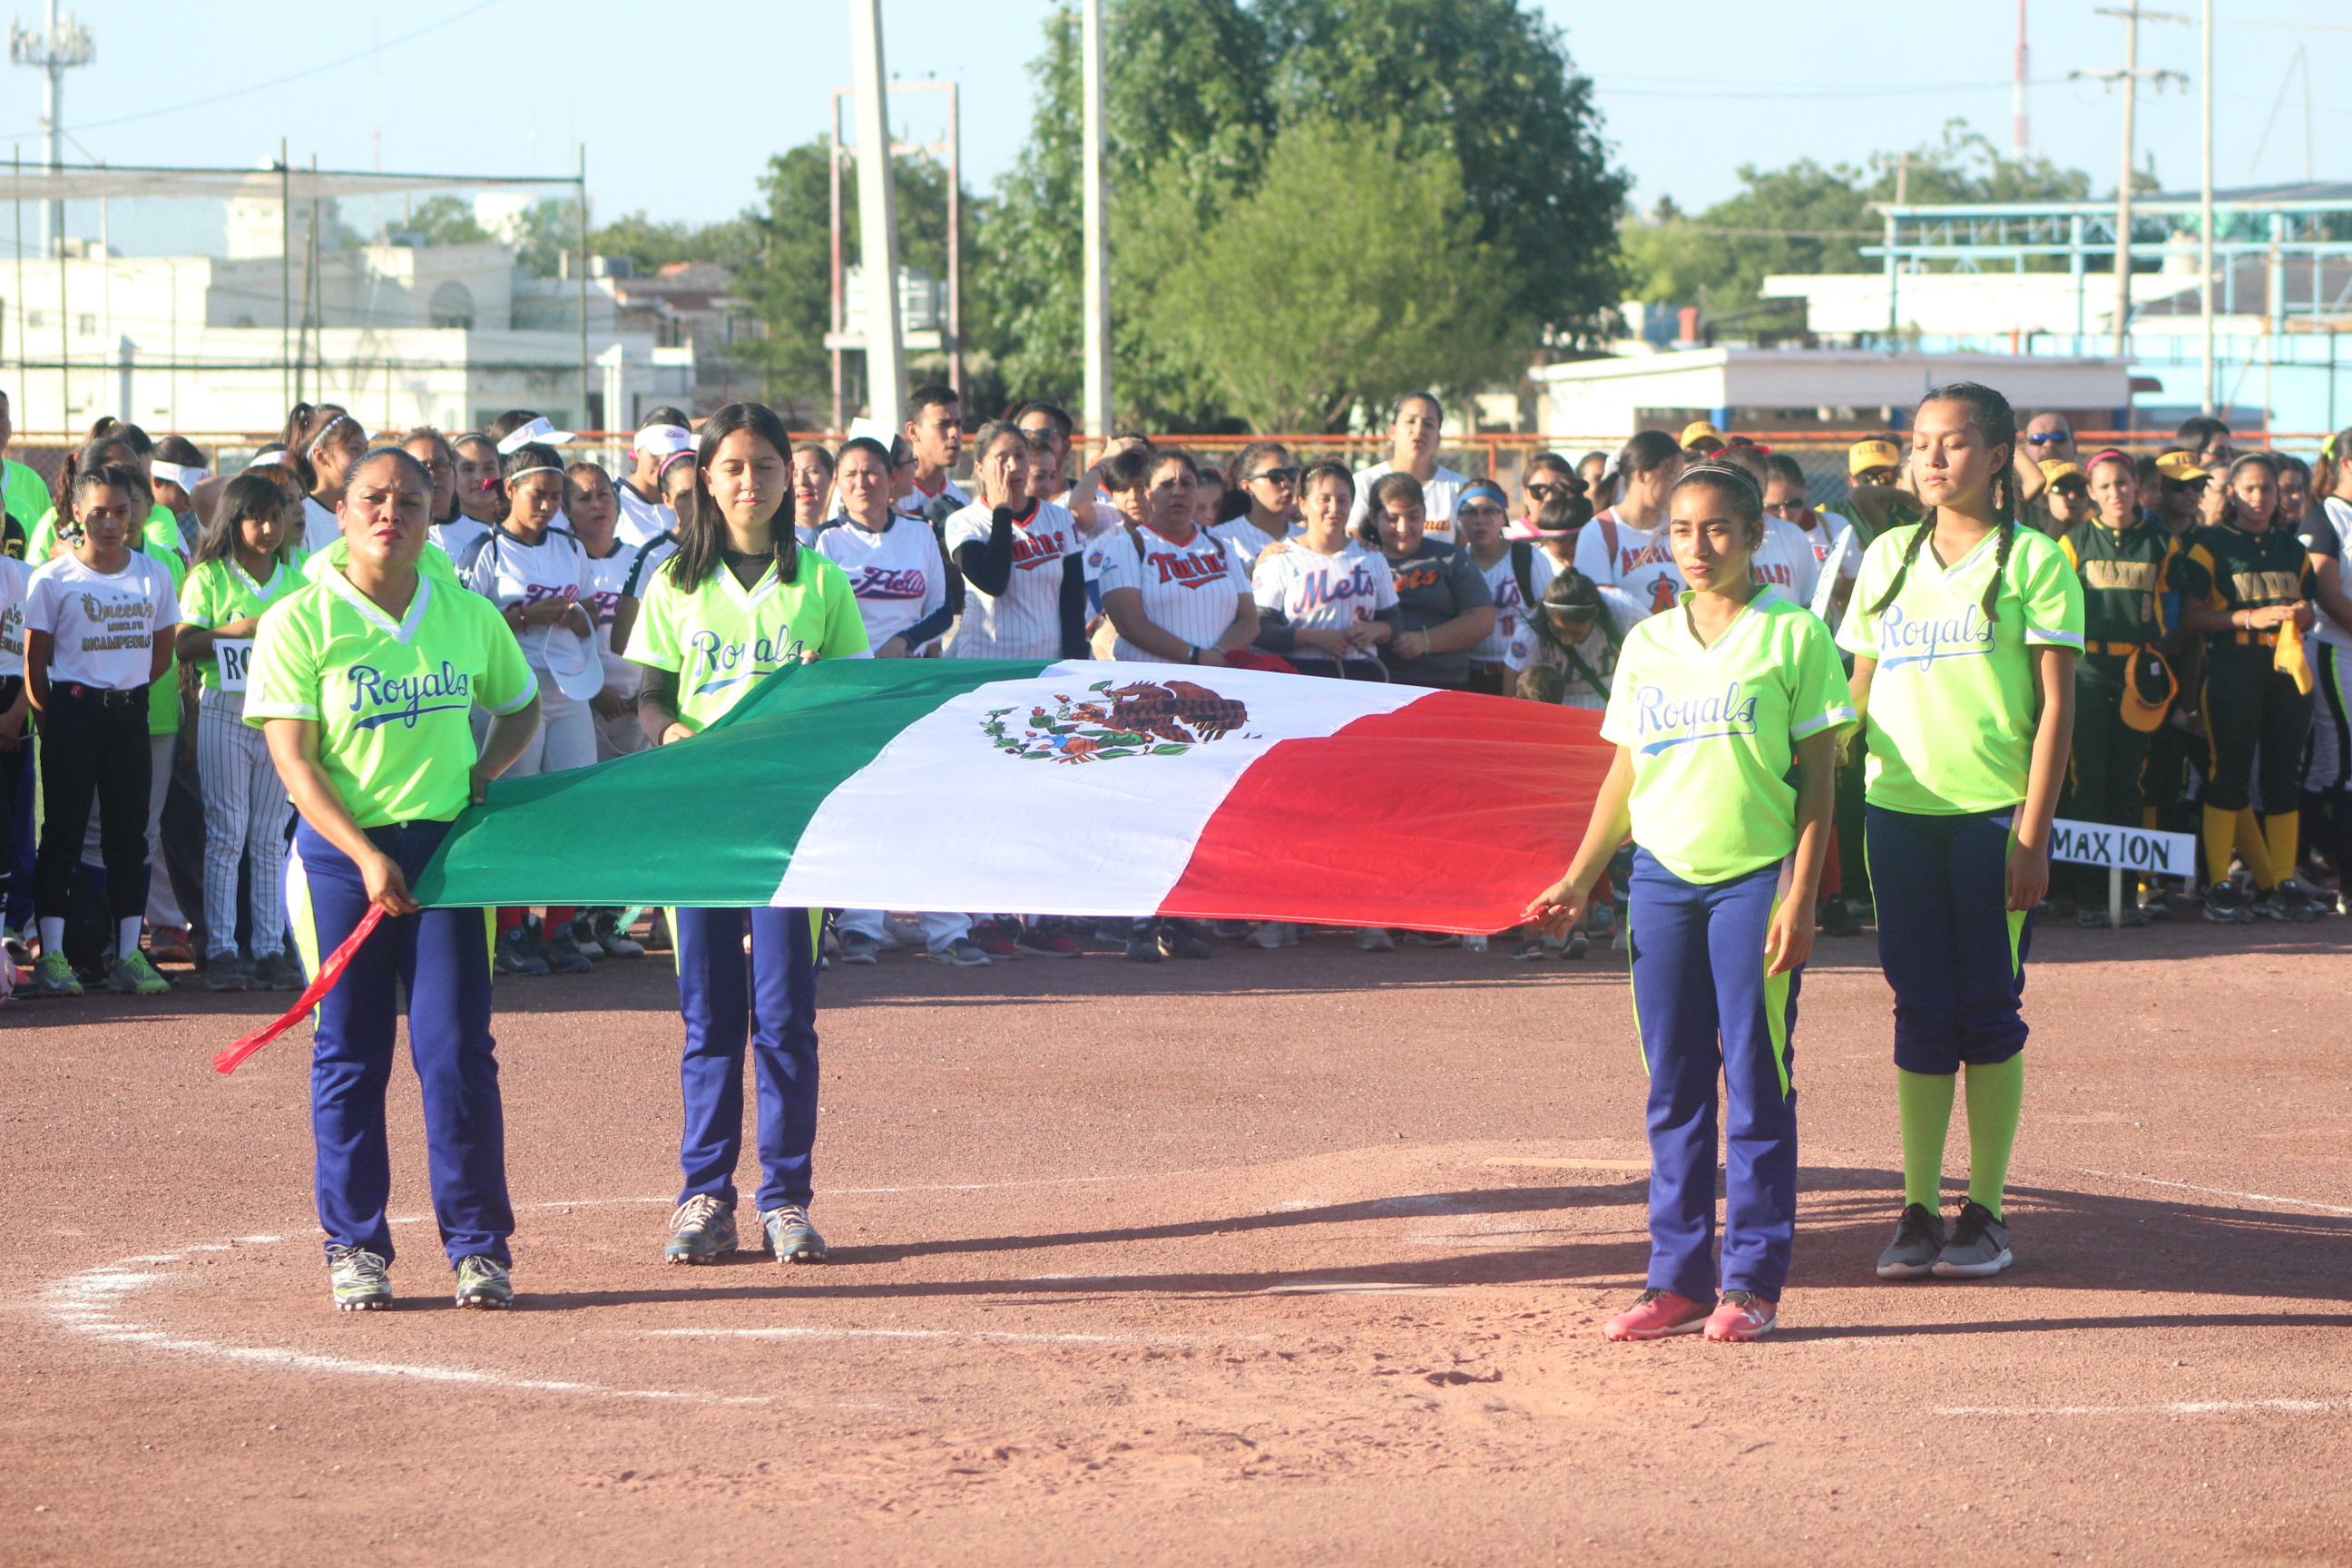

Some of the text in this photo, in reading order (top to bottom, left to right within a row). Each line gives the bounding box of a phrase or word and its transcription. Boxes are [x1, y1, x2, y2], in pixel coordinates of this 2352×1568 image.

[1147, 551, 1228, 583] Twin
[1392, 568, 1438, 593] ets
[2085, 559, 2157, 592] MAXION
[1293, 564, 1376, 615] Mets
[81, 593, 156, 623] Queen's
[81, 634, 152, 652] BICAMPEONAS
[1880, 603, 1994, 672] Royals
[348, 661, 469, 729] Royals
[1636, 681, 1759, 754] Royals
